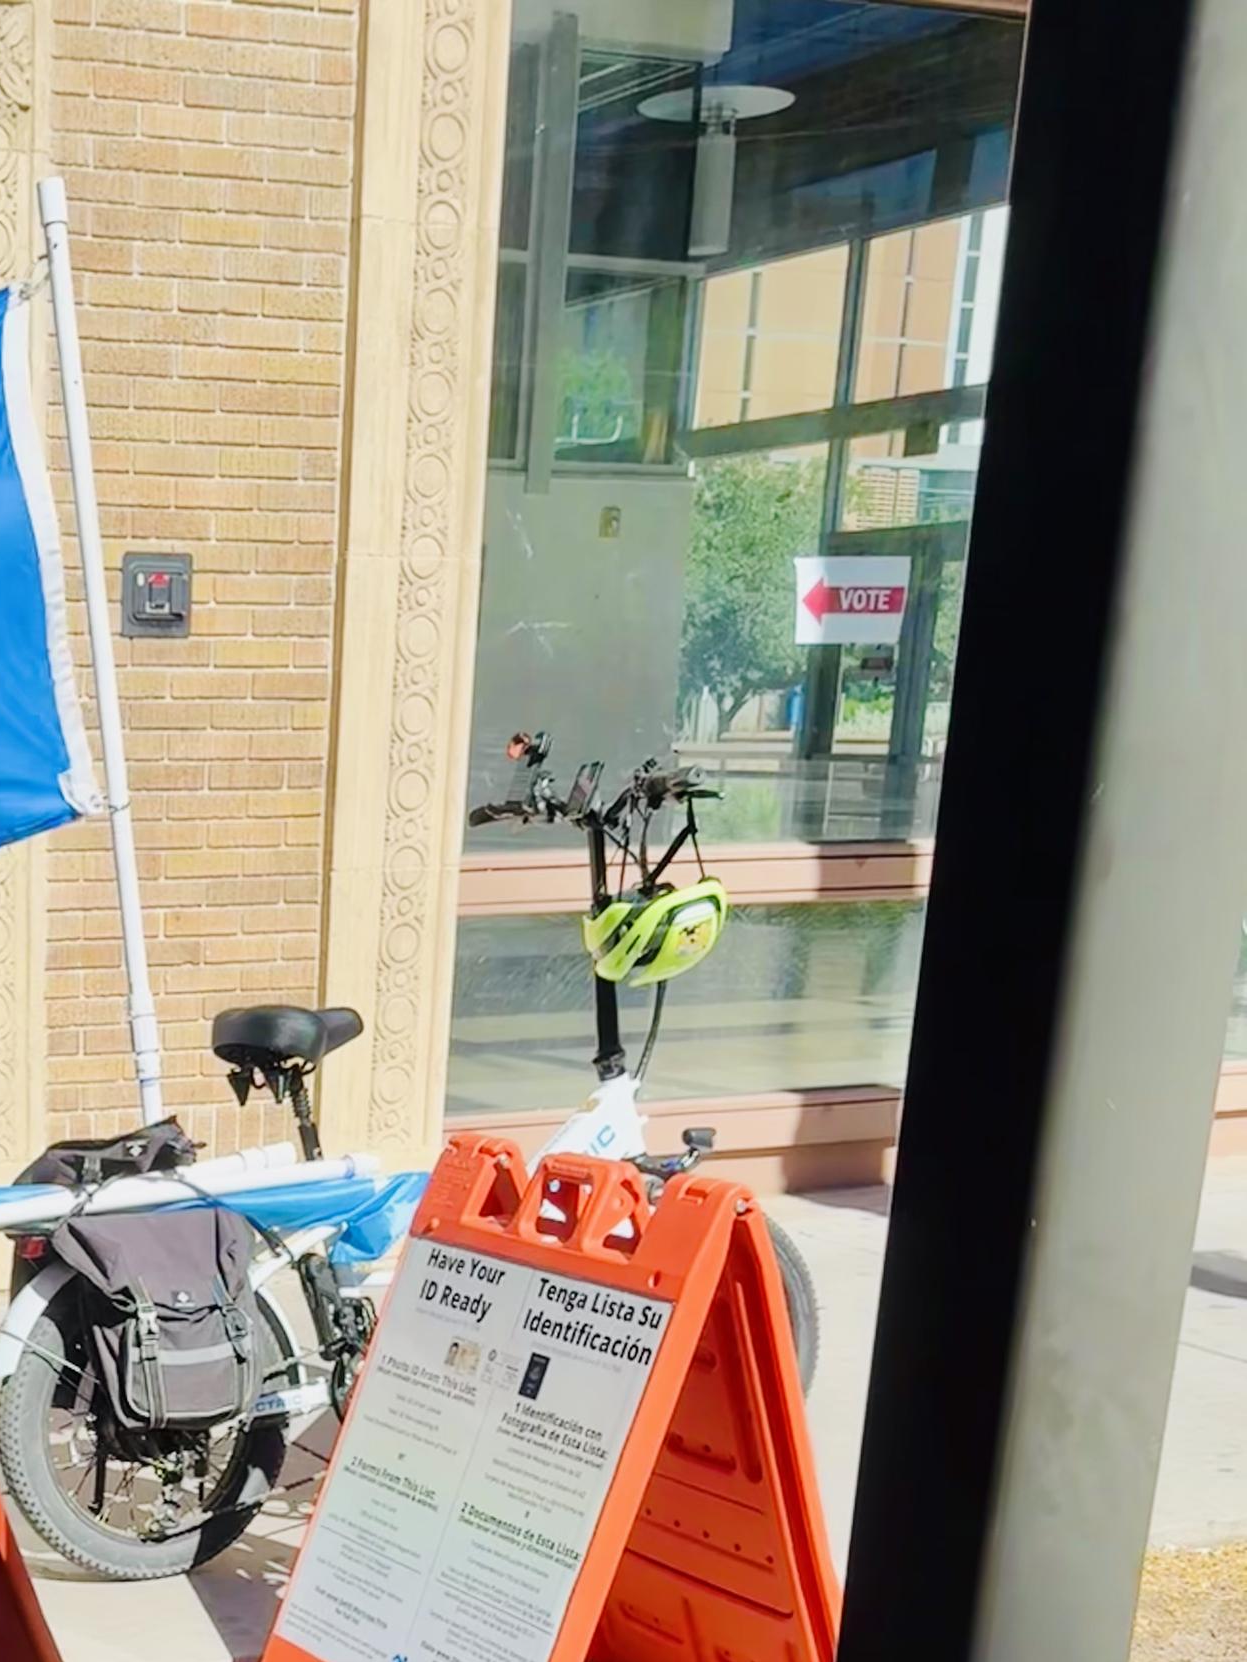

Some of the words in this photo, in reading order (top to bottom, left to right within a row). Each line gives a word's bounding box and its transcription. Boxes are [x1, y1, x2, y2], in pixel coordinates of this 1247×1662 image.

[839, 588, 892, 611] VOTE
[427, 1248, 465, 1275] Have
[470, 1258, 505, 1285] Your
[419, 1279, 437, 1301] ID
[439, 1284, 492, 1323] Ready
[538, 1278, 588, 1313] Tenga
[591, 1292, 635, 1322] Lista
[638, 1305, 663, 1329] Su
[523, 1308, 652, 1366] Identificación
[466, 1503, 524, 1537] Documentos
[534, 1533, 556, 1551] Esta
